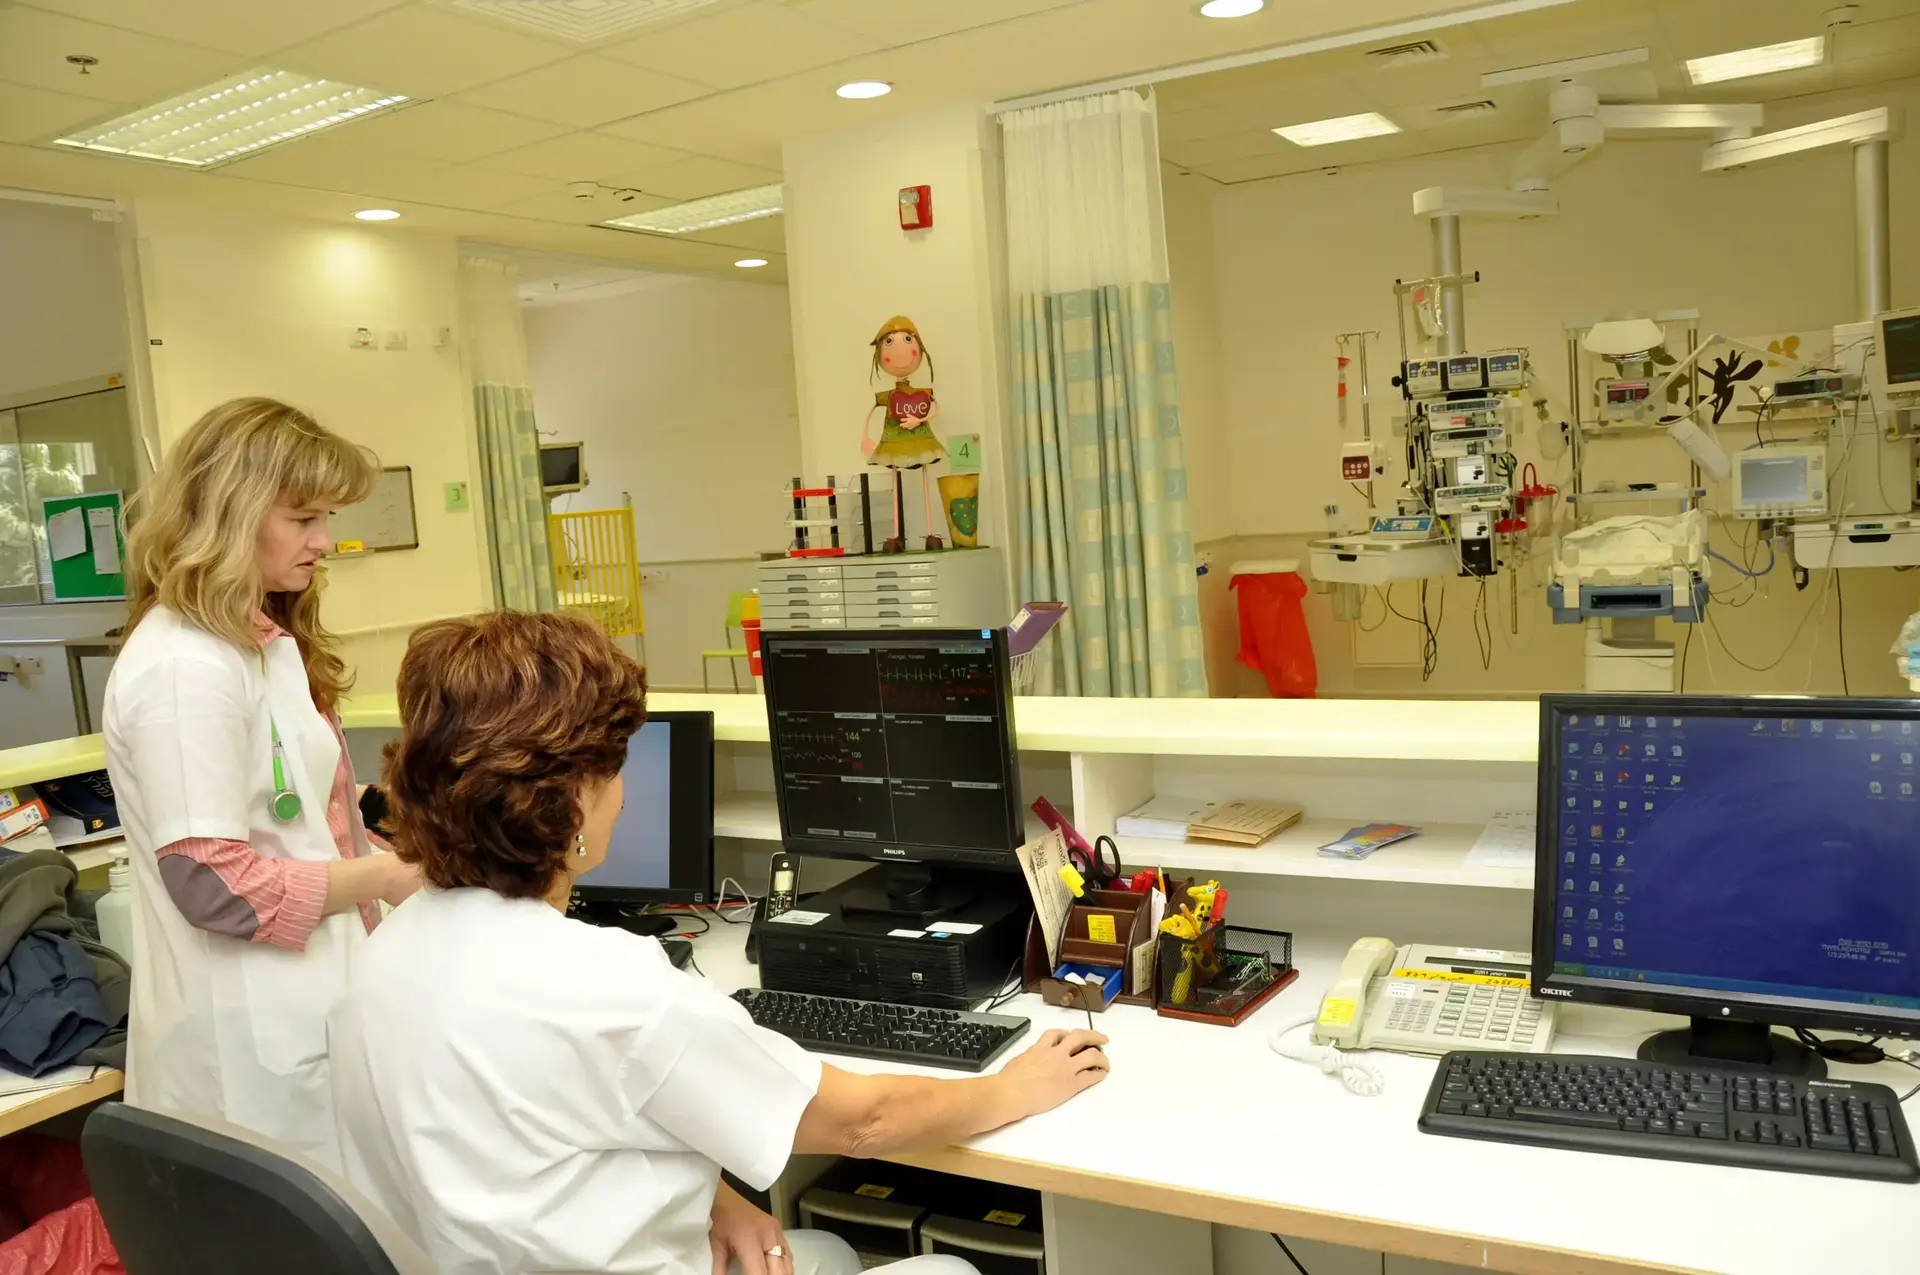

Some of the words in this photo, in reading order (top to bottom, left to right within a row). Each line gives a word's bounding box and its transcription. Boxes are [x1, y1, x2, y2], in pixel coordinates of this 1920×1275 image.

[895, 402, 928, 415] Love
[958, 442, 970, 459] 4
[451, 488, 461, 502] 3
[950, 667, 966, 678] 117
[845, 731, 860, 742] 144
[883, 848, 906, 856] PHILIPS
[1808, 1080, 1852, 1089] Microsoft
